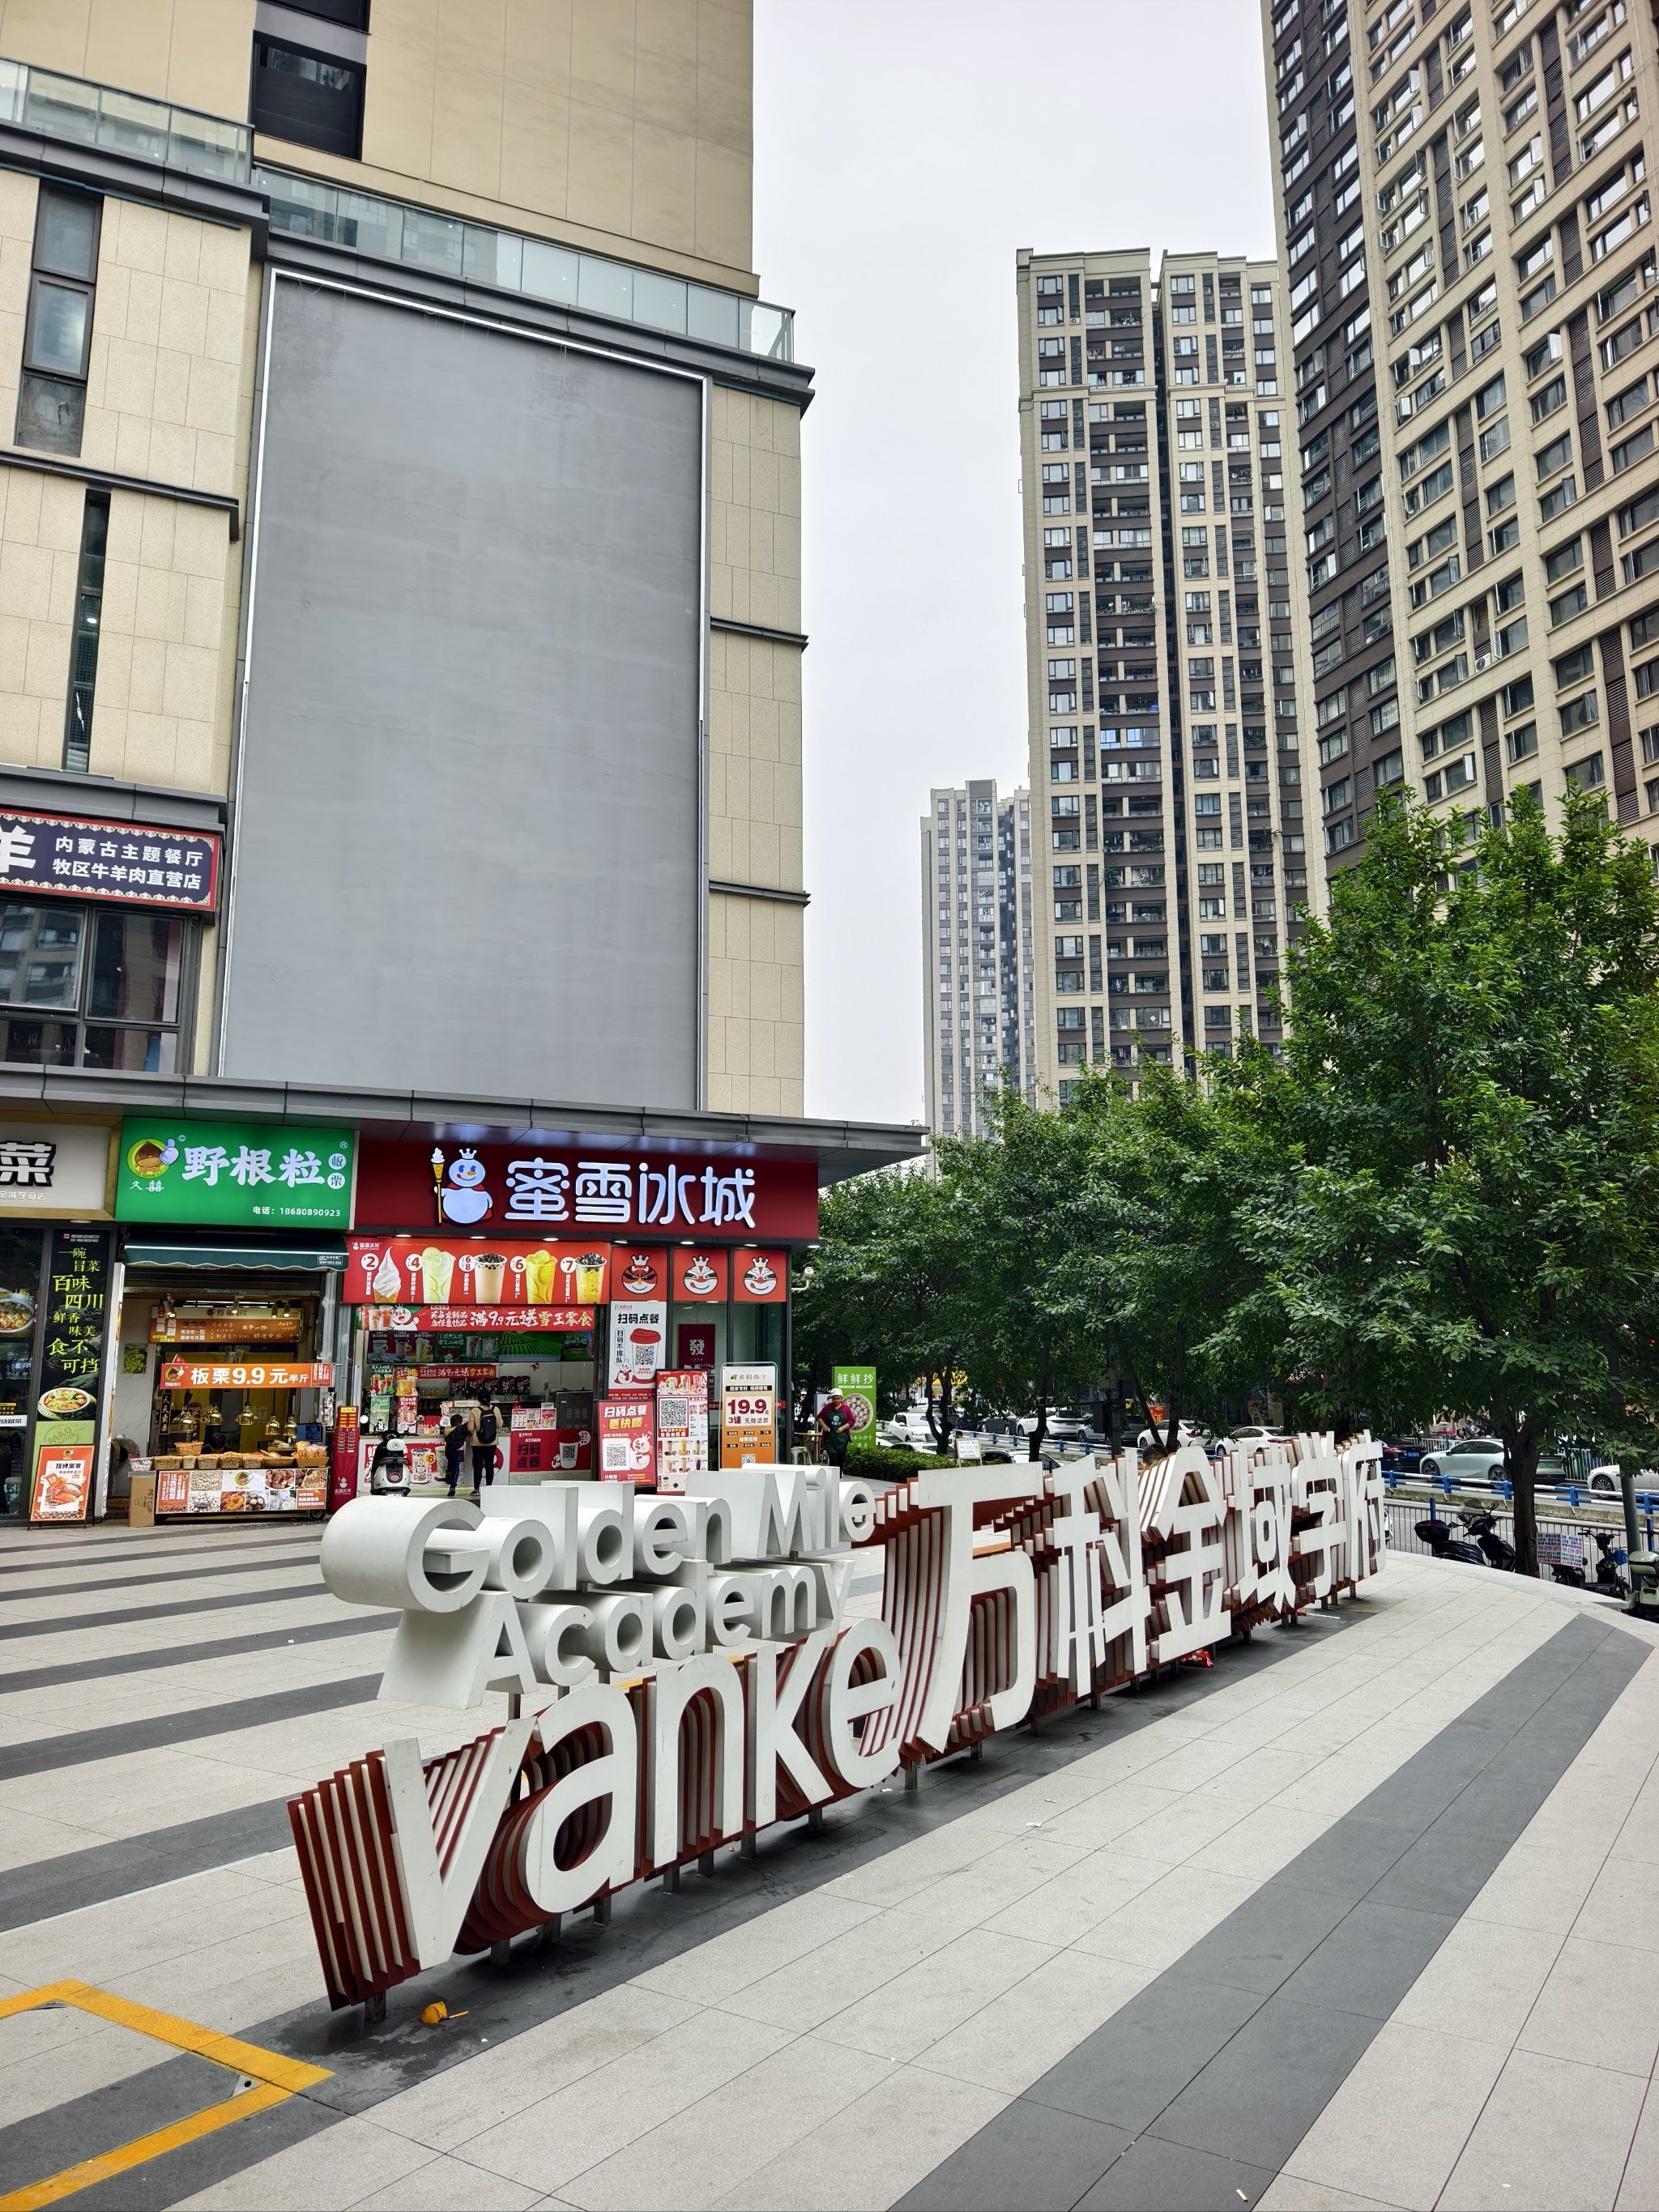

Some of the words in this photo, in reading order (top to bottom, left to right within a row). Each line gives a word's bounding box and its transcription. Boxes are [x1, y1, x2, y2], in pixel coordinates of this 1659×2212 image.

[55, 836, 203, 867] 内蒙古主题餐厅
[53, 858, 202, 890] 牧区牛羊肉直营店
[0, 1140, 56, 1187] 菜
[181, 1145, 325, 1188] 野根粒
[330, 1153, 343, 1188] 板栗
[505, 1157, 755, 1229] 蜜雪冰城
[279, 1208, 340, 1217] 18680890923
[58, 1247, 87, 1259] 一碗
[74, 1260, 100, 1272] 冒菜
[53, 1275, 92, 1292] 百味
[66, 1294, 103, 1310] 四川
[53, 1312, 81, 1323] 鲜香
[618, 1313, 659, 1324] 扫码点餐
[69, 1326, 96, 1336] 味美
[47, 1338, 88, 1355] 食不
[689, 1339, 705, 1355] 發
[61, 1358, 98, 1375] 可挡
[191, 1367, 309, 1386] 板栗9.9元半斤
[838, 1373, 873, 1384] 鲜鲜抄
[604, 1405, 647, 1417] 扫码点餐
[609, 1417, 642, 1430] 更快哦
[403, 1481, 731, 1613] Golden
[752, 1464, 876, 1558] Mile
[915, 1430, 1386, 1754] 万科金域学府
[483, 1559, 855, 1694] Academy
